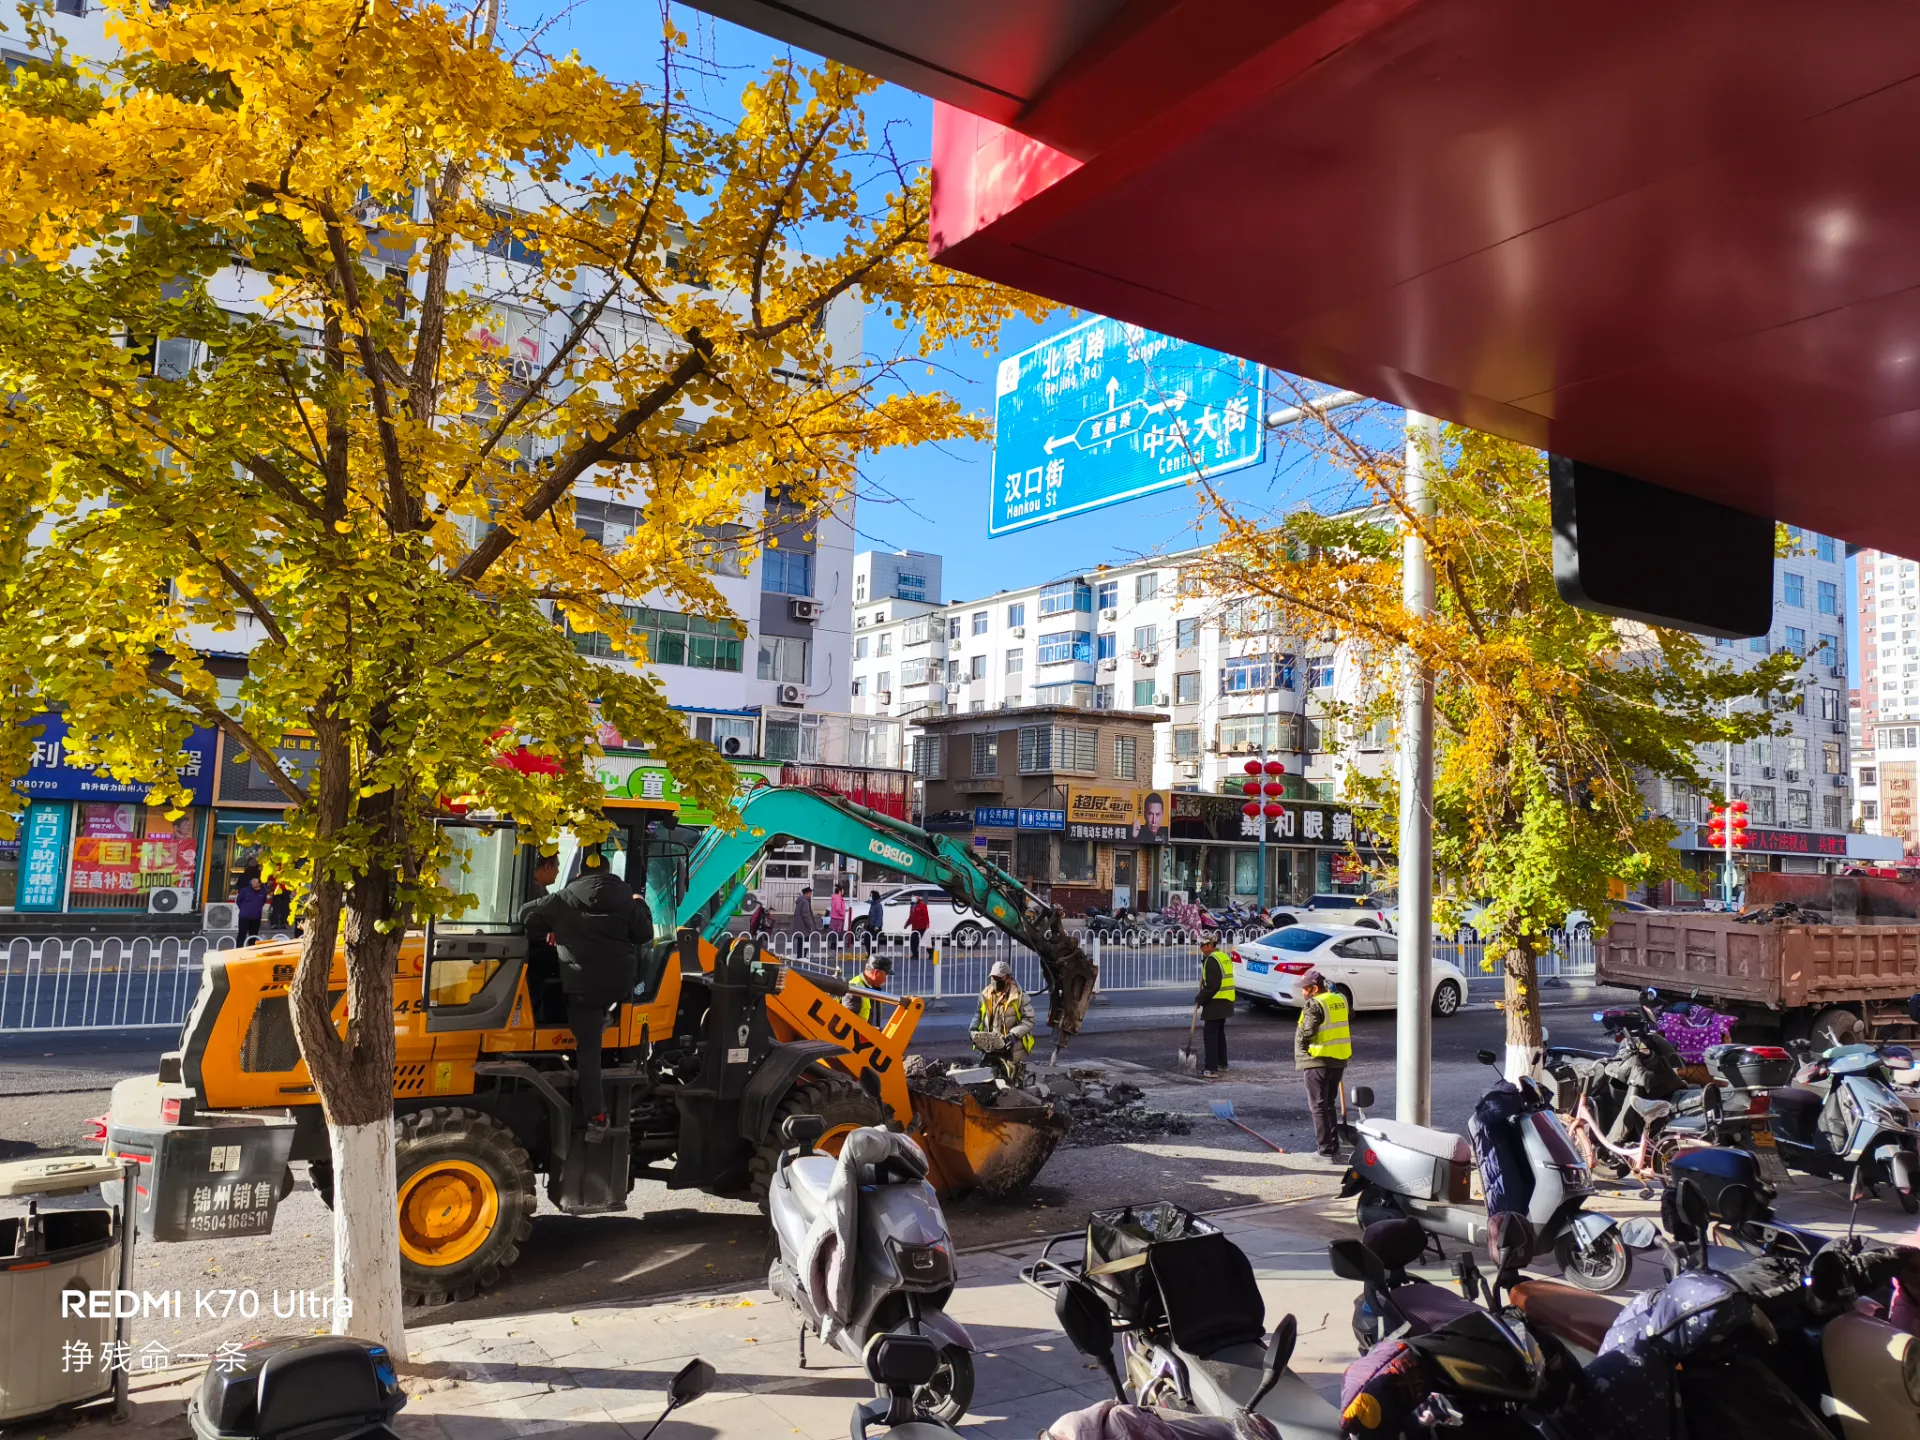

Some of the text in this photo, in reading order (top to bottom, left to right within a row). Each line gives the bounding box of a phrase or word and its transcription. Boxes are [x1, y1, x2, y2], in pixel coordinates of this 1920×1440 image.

[1042, 327, 1105, 380] 北京路
[1044, 374, 1078, 398] Beijing
[1143, 395, 1249, 459] 中央大街
[1158, 437, 1230, 475] Central St
[1004, 457, 1065, 504] 汉口街
[1006, 489, 1057, 520] Hankou St
[1035, 811, 1063, 823] 公共厕所
[868, 838, 914, 867] KOBELCO
[807, 998, 893, 1073] LUYU
[193, 1181, 271, 1213] 锦州销售
[190, 1210, 268, 1232] 13504168510
